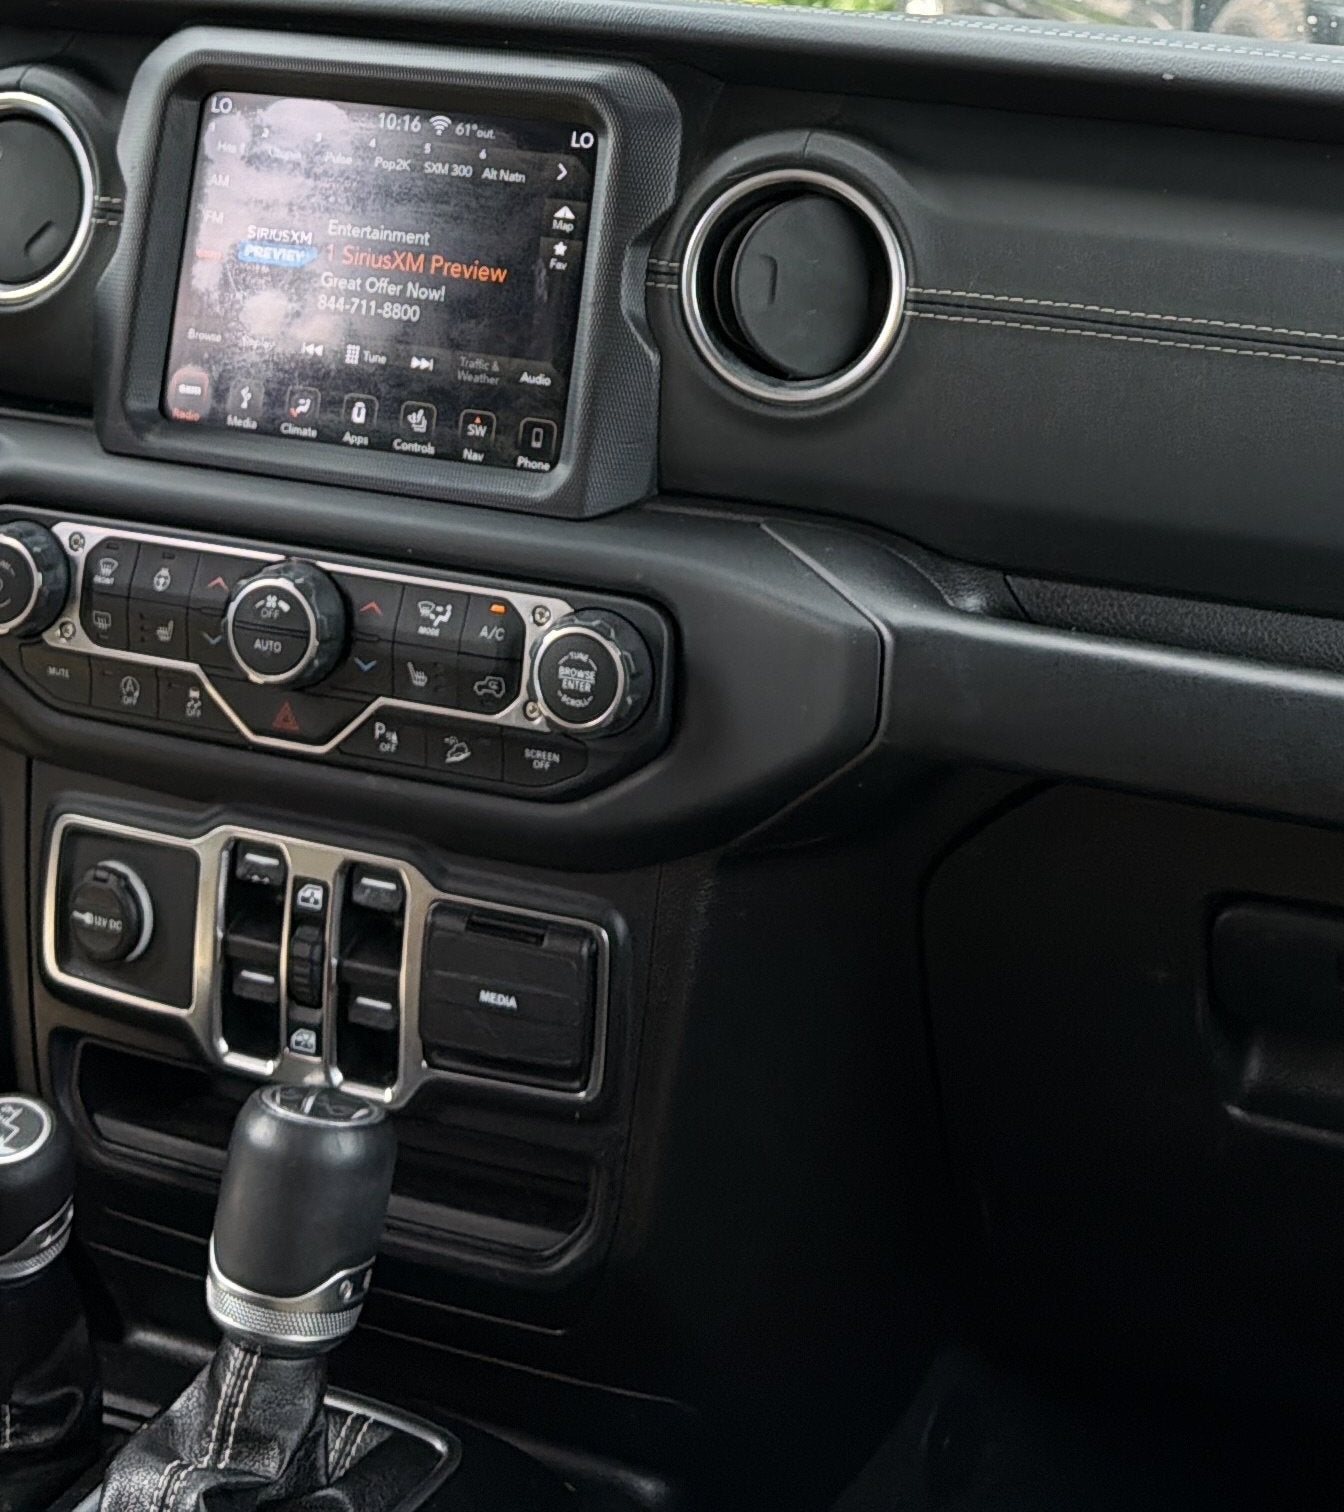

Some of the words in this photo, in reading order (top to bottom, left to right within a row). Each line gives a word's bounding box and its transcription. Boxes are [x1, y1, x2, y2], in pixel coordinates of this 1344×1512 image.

[211, 97, 233, 114] LO
[378, 112, 422, 133] 10:16
[423, 142, 432, 154] 5
[571, 131, 595, 149] LO
[479, 148, 487, 160] 6
[374, 155, 412, 172] Pop2K
[423, 161, 450, 176] SXM
[450, 164, 473, 178] 300
[481, 167, 498, 181] Alt
[499, 169, 526, 184] Natn
[247, 224, 314, 246] SIRIUSXM
[328, 218, 431, 247] Entertainment
[552, 219, 574, 234] Map
[326, 243, 335, 262] 1
[342, 244, 425, 274] SiriusXM
[429, 254, 509, 284] Preview
[549, 257, 568, 271] Fav
[321, 271, 362, 292] Great
[365, 276, 404, 297] Offer
[406, 281, 447, 302] Now!
[317, 294, 421, 323] 844-711-8800
[187, 327, 223, 343] Browse
[362, 350, 388, 366] Tune
[459, 355, 490, 372] Traffic
[457, 370, 501, 386] Weather
[519, 371, 552, 387] Audio
[227, 414, 258, 431] Media
[280, 422, 318, 439] Climate
[467, 423, 488, 438] SW
[342, 430, 369, 447] Apps
[392, 438, 436, 456] Controls
[462, 447, 485, 463] Nav
[516, 455, 551, 472] Phone
[260, 607, 280, 619] OFF
[417, 625, 441, 637] MODE
[478, 625, 505, 641] A/C
[253, 637, 282, 654] AUTO
[47, 665, 71, 679] MUTE
[558, 665, 596, 681] BROWSE
[561, 677, 592, 693] ENTER
[378, 741, 397, 753] OFF
[523, 747, 561, 764] SCREEN
[532, 759, 552, 771] OFF
[478, 988, 518, 1010] MEDIA
